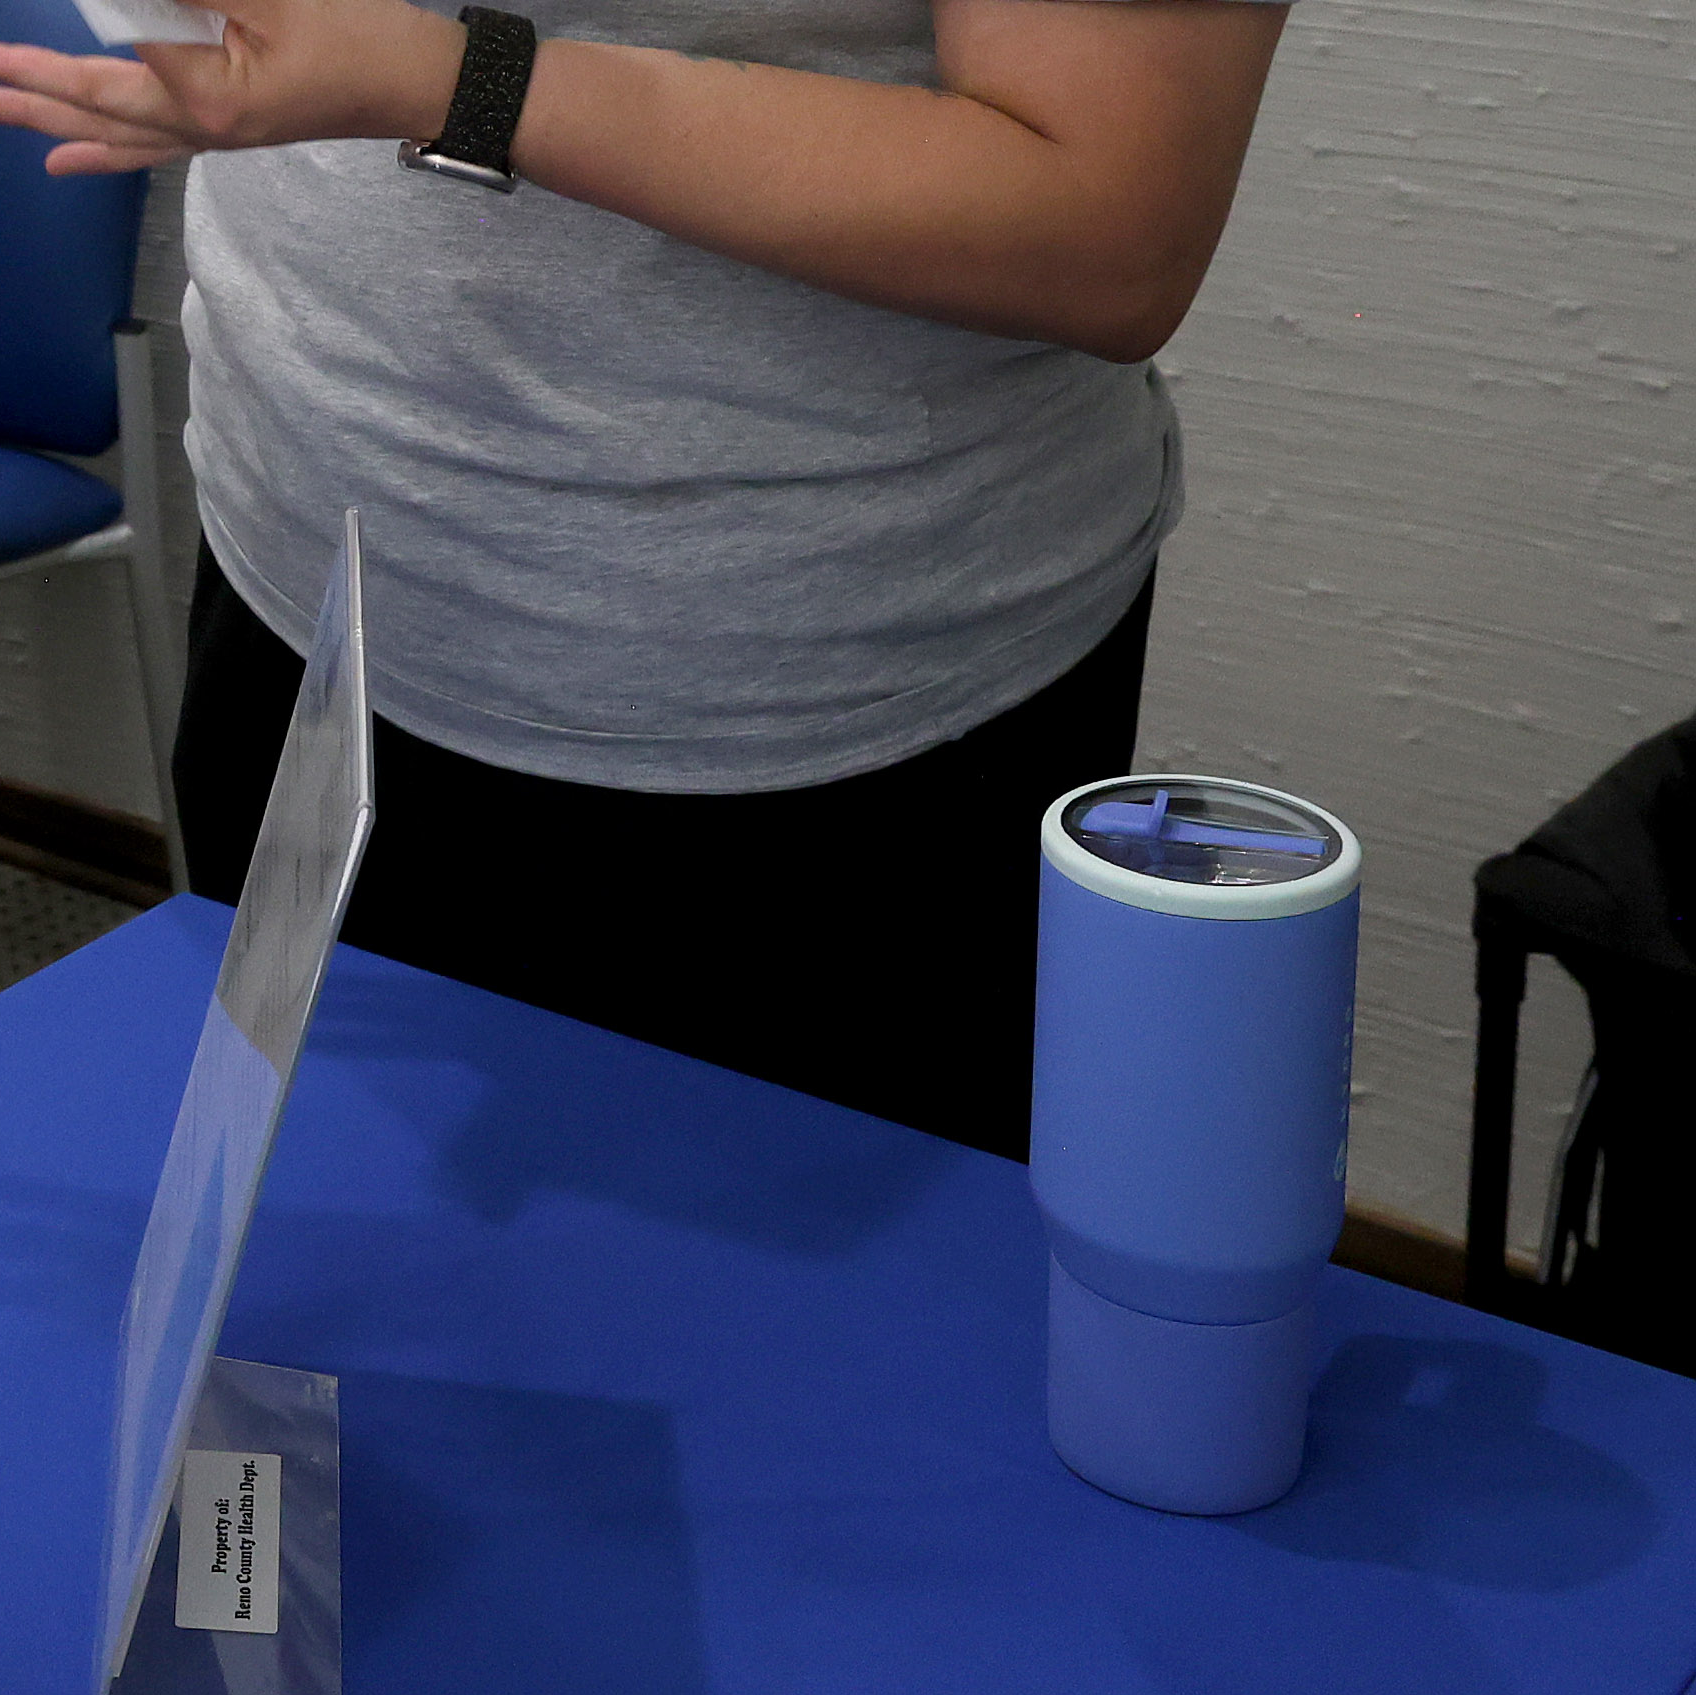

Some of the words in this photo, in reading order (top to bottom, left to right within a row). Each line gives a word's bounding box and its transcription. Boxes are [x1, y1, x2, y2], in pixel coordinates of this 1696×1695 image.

[239, 1460, 259, 1493] Dept.
[214, 1498, 230, 1515] of:
[237, 1494, 254, 1535] Health
[211, 1517, 233, 1574] Property
[236, 1537, 256, 1584] County
[235, 1586, 251, 1620] Reno
